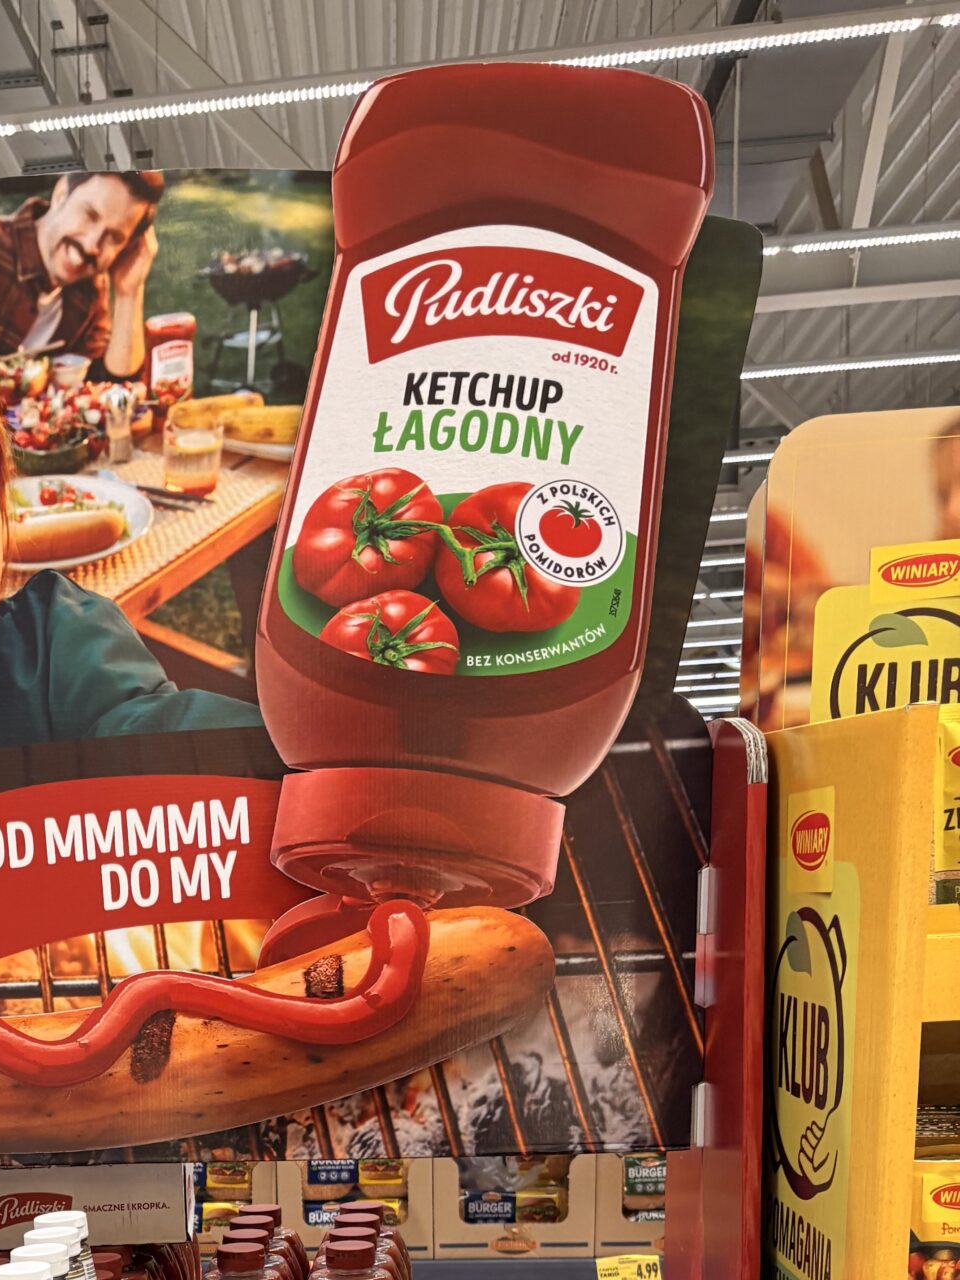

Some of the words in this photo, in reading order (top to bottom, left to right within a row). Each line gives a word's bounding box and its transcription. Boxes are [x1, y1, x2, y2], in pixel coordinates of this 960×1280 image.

[385, 259, 618, 344] Pudliszki
[552, 351, 571, 363] od
[574, 353, 608, 371] 1920
[403, 372, 563, 413] KETCHUP
[373, 409, 584, 465] ŁAGODNY
[537, 492, 549, 505] Z
[550, 484, 616, 527] POLSKICH
[524, 534, 608, 579] POMIDORÓW
[890, 559, 959, 581] WINIARY
[466, 653, 492, 668] BEZ
[495, 623, 607, 667] KONSERWANTÓW
[44, 796, 250, 864] MMMMM
[796, 827, 828, 855] WINIARY
[101, 859, 159, 911] DO
[170, 850, 237, 904] MY
[777, 993, 830, 1111] KLUB
[82, 1202, 124, 1213] SMACZNE
[132, 1201, 171, 1211] KROPKA.
[637, 1262, 658, 1280] 4.99
